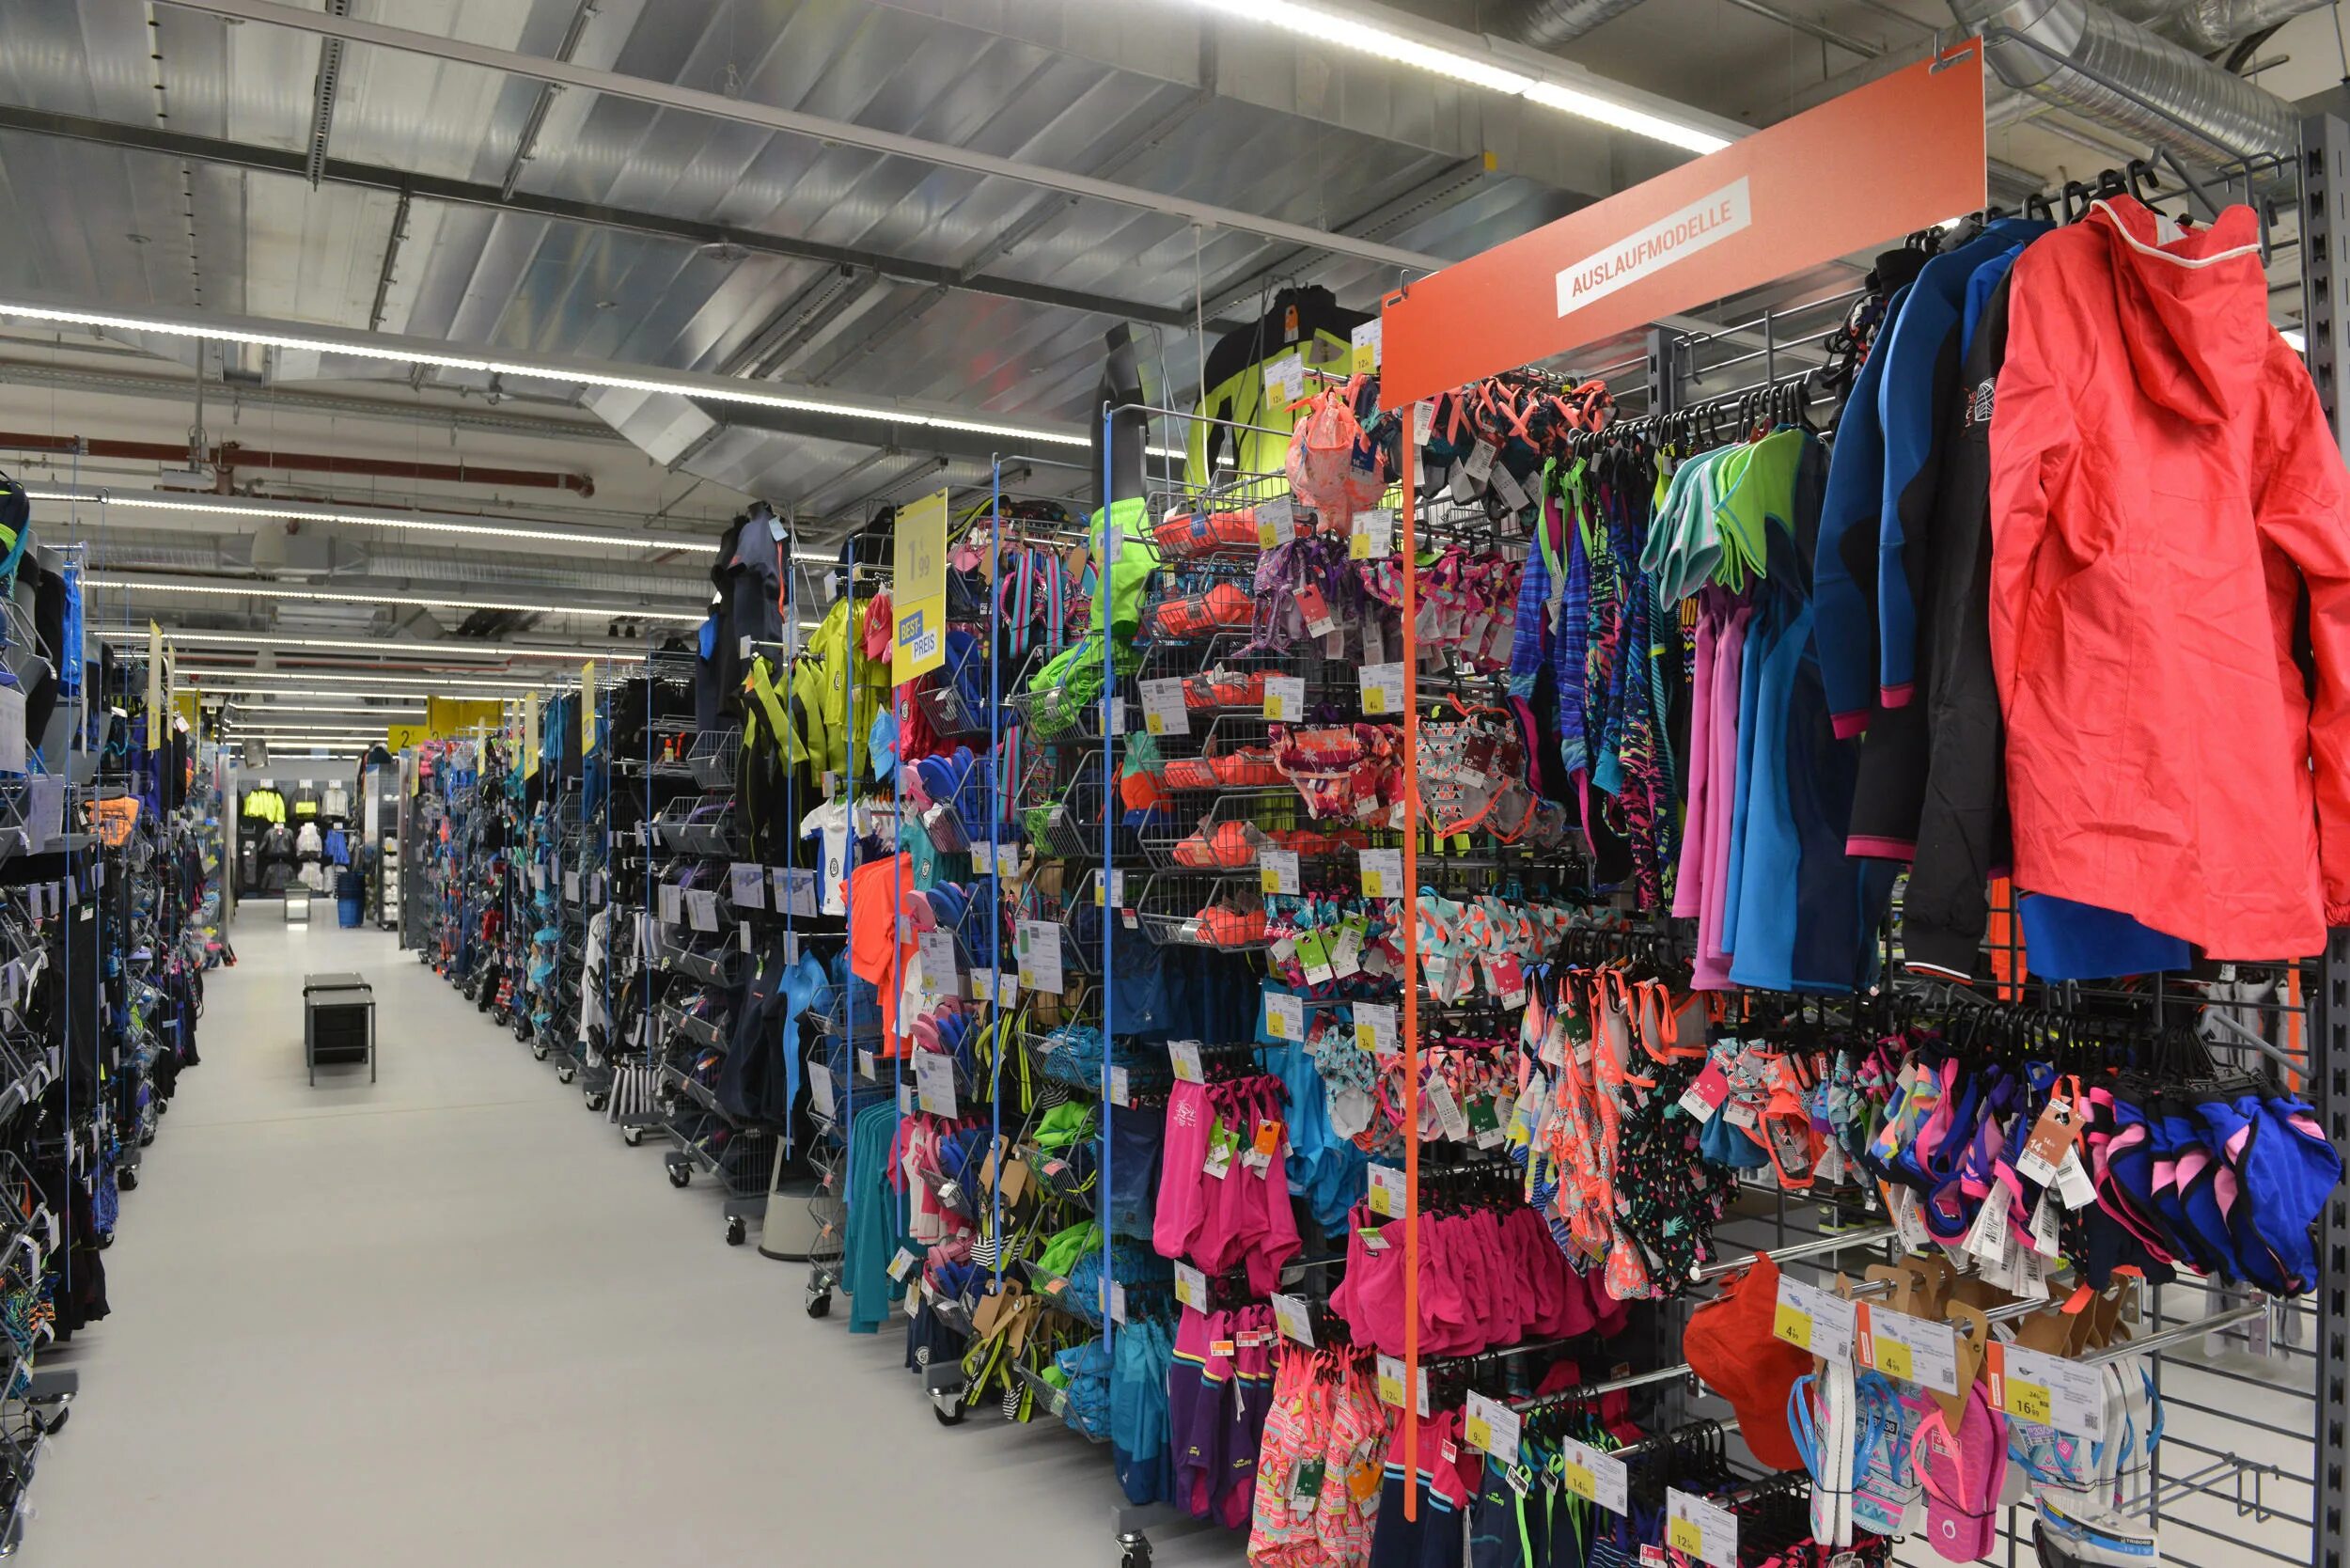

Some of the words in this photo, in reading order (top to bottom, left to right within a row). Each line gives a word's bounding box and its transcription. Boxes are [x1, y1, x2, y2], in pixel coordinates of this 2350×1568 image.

[1572, 199, 1731, 297] AUSLAUFMODELLE
[901, 617, 921, 641] BEST-
[914, 634, 934, 659] PREIS
